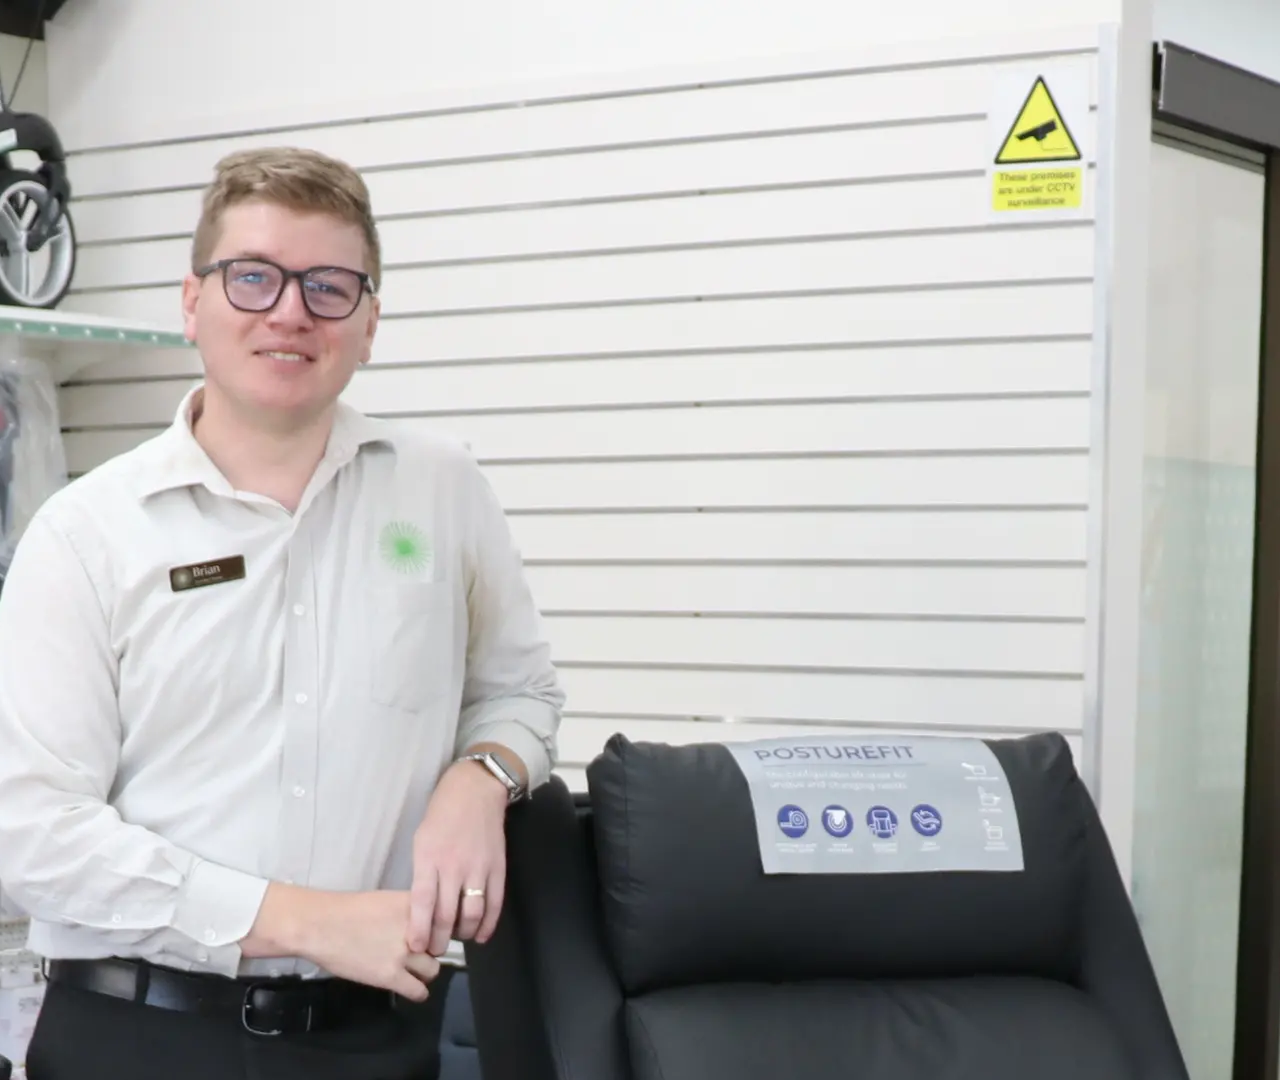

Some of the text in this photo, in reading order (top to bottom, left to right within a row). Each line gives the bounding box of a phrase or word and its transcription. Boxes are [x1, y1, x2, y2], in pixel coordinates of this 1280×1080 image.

[999, 170, 1076, 182] These premises
[998, 182, 1076, 195] are under CCTV
[192, 563, 221, 577] Brian
[754, 744, 915, 761] POSTUREFIT
